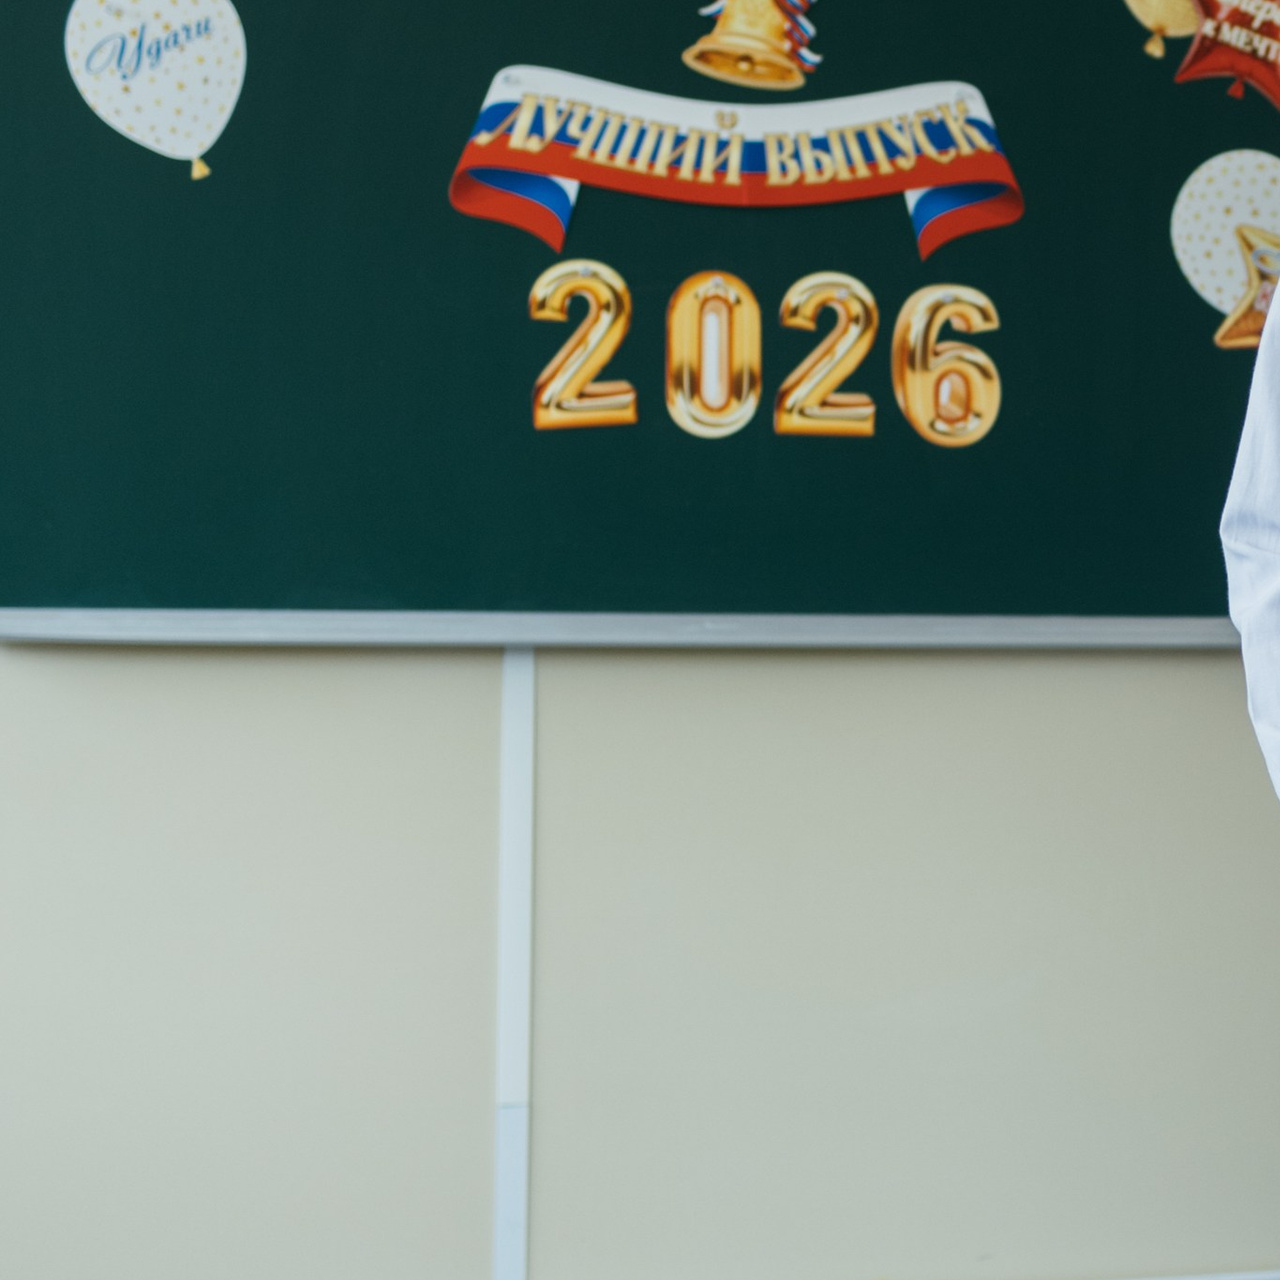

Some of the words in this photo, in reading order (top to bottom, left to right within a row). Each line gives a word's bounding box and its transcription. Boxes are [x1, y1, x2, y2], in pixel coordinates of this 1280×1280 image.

[474, 93, 743, 186] ЛУЧШИЙ
[764, 99, 996, 187] ВЫПУСК
[529, 259, 1001, 447] 2026
